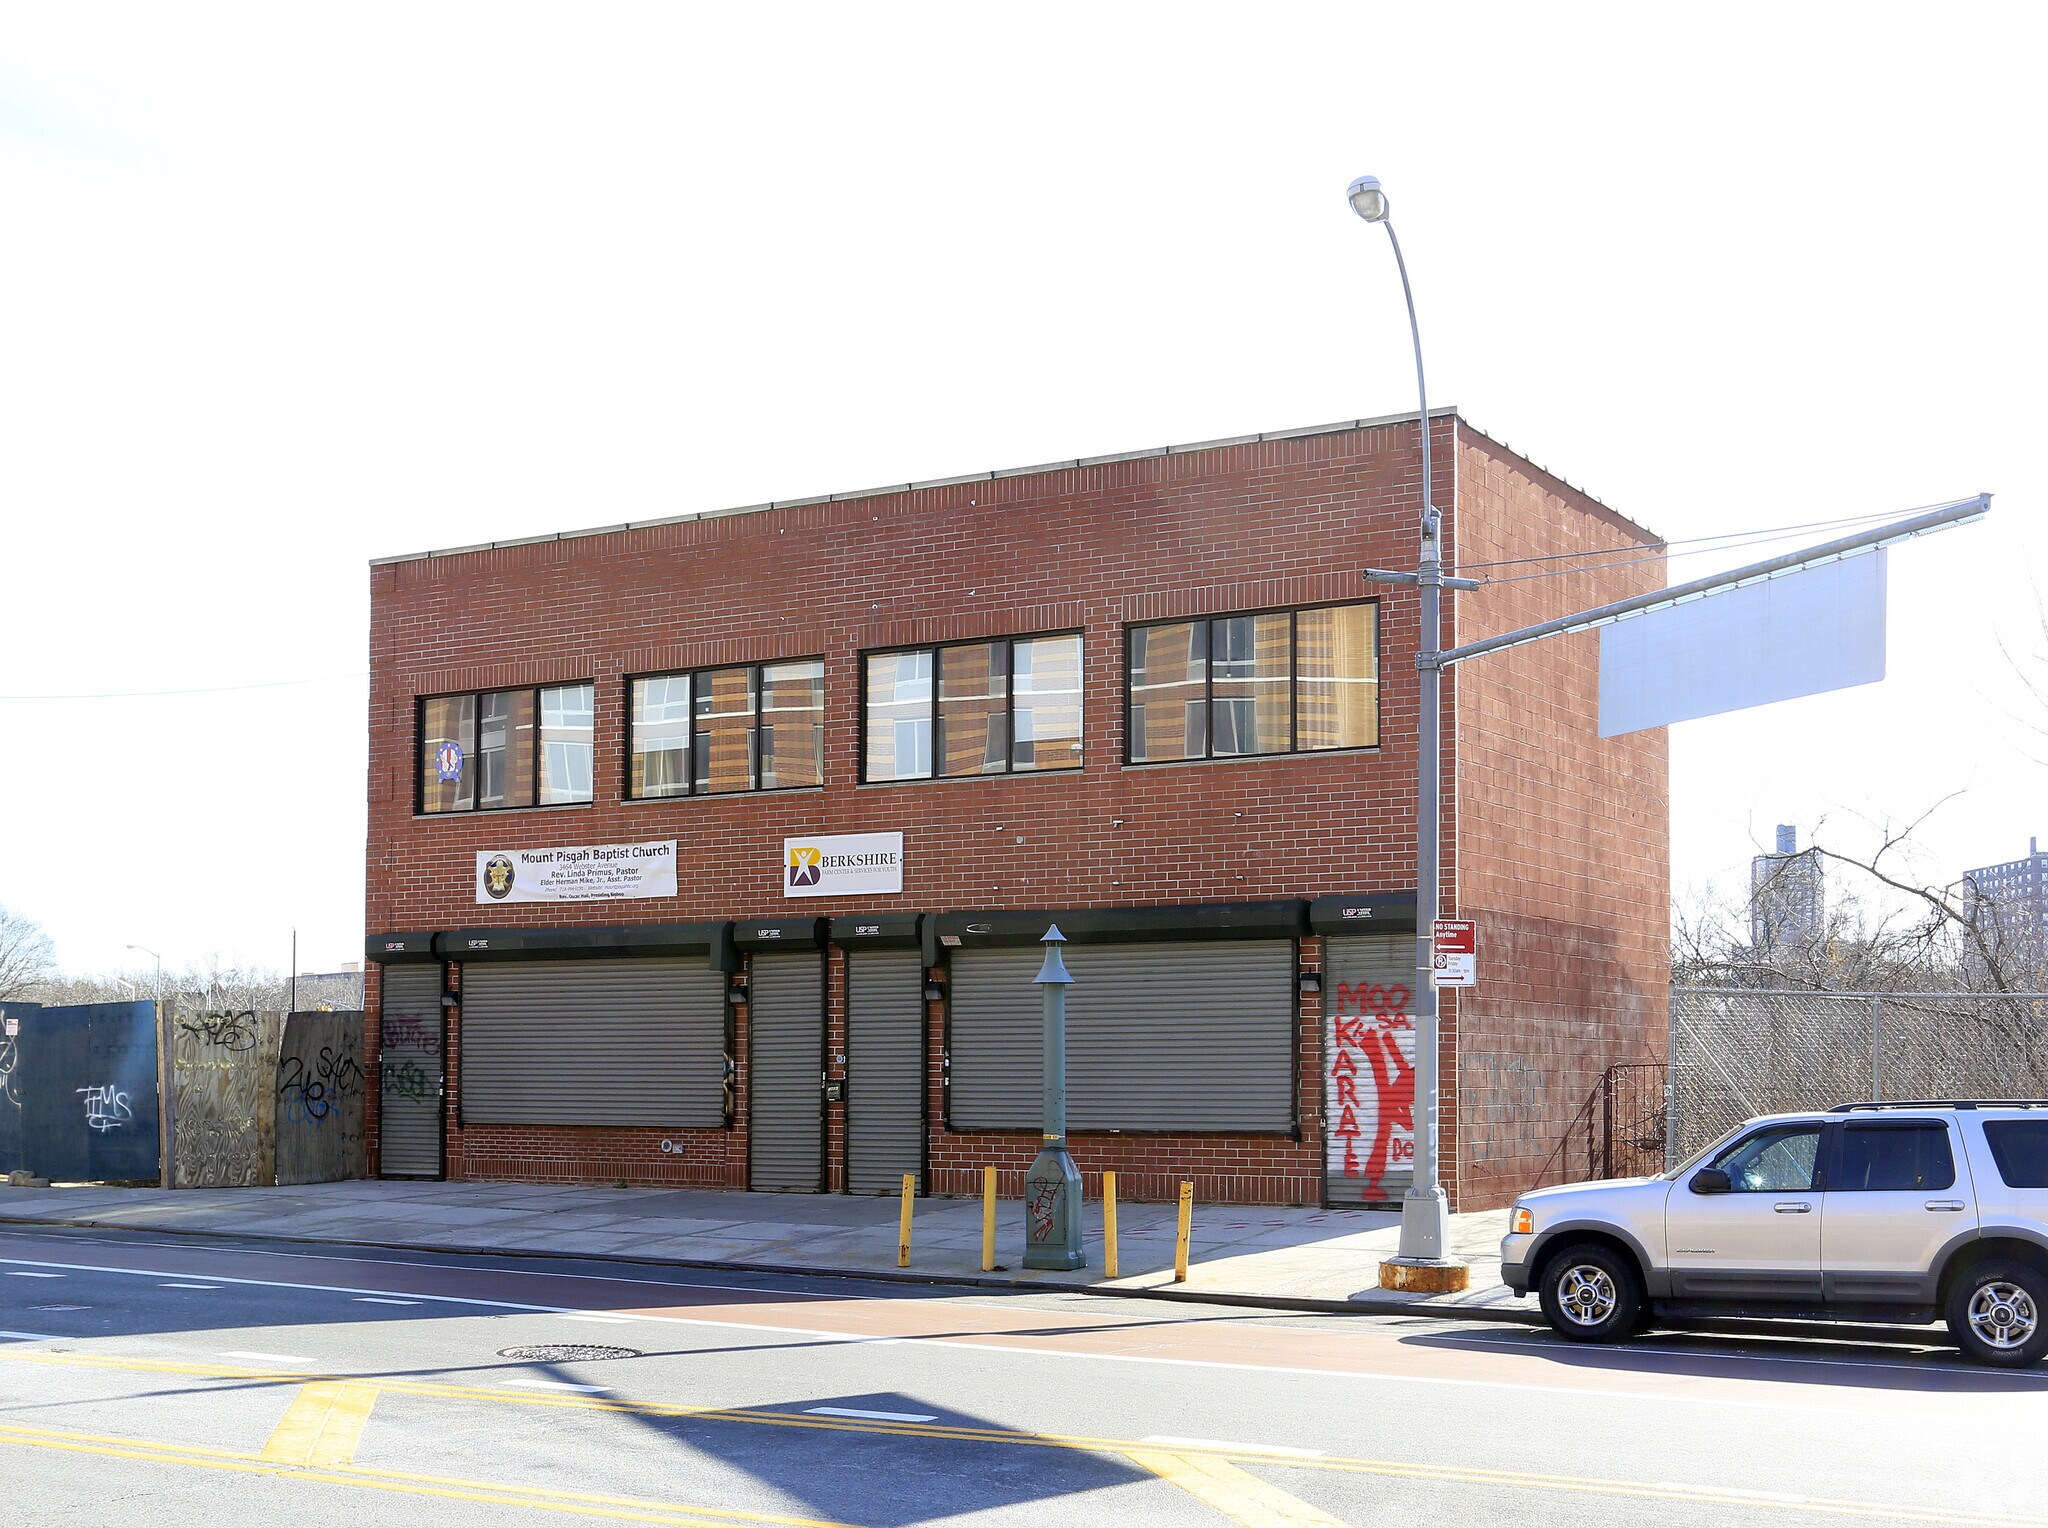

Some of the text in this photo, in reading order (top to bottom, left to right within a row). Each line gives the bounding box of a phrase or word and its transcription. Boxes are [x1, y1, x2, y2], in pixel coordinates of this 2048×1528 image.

[521, 845, 670, 863] Mount Pisgah Baptist Church
[822, 852, 897, 868] BERKSHIRE
[551, 867, 639, 879] Rev. Linda Primus, Pastor
[579, 877, 595, 885] Mike,
[607, 875, 622, 883] Asst.
[1435, 923, 1470, 931] NO STANDING
[1435, 931, 1458, 939] Anytime
[1337, 981, 1412, 1014] MOO
[1331, 1015, 1362, 1178] KARATE
